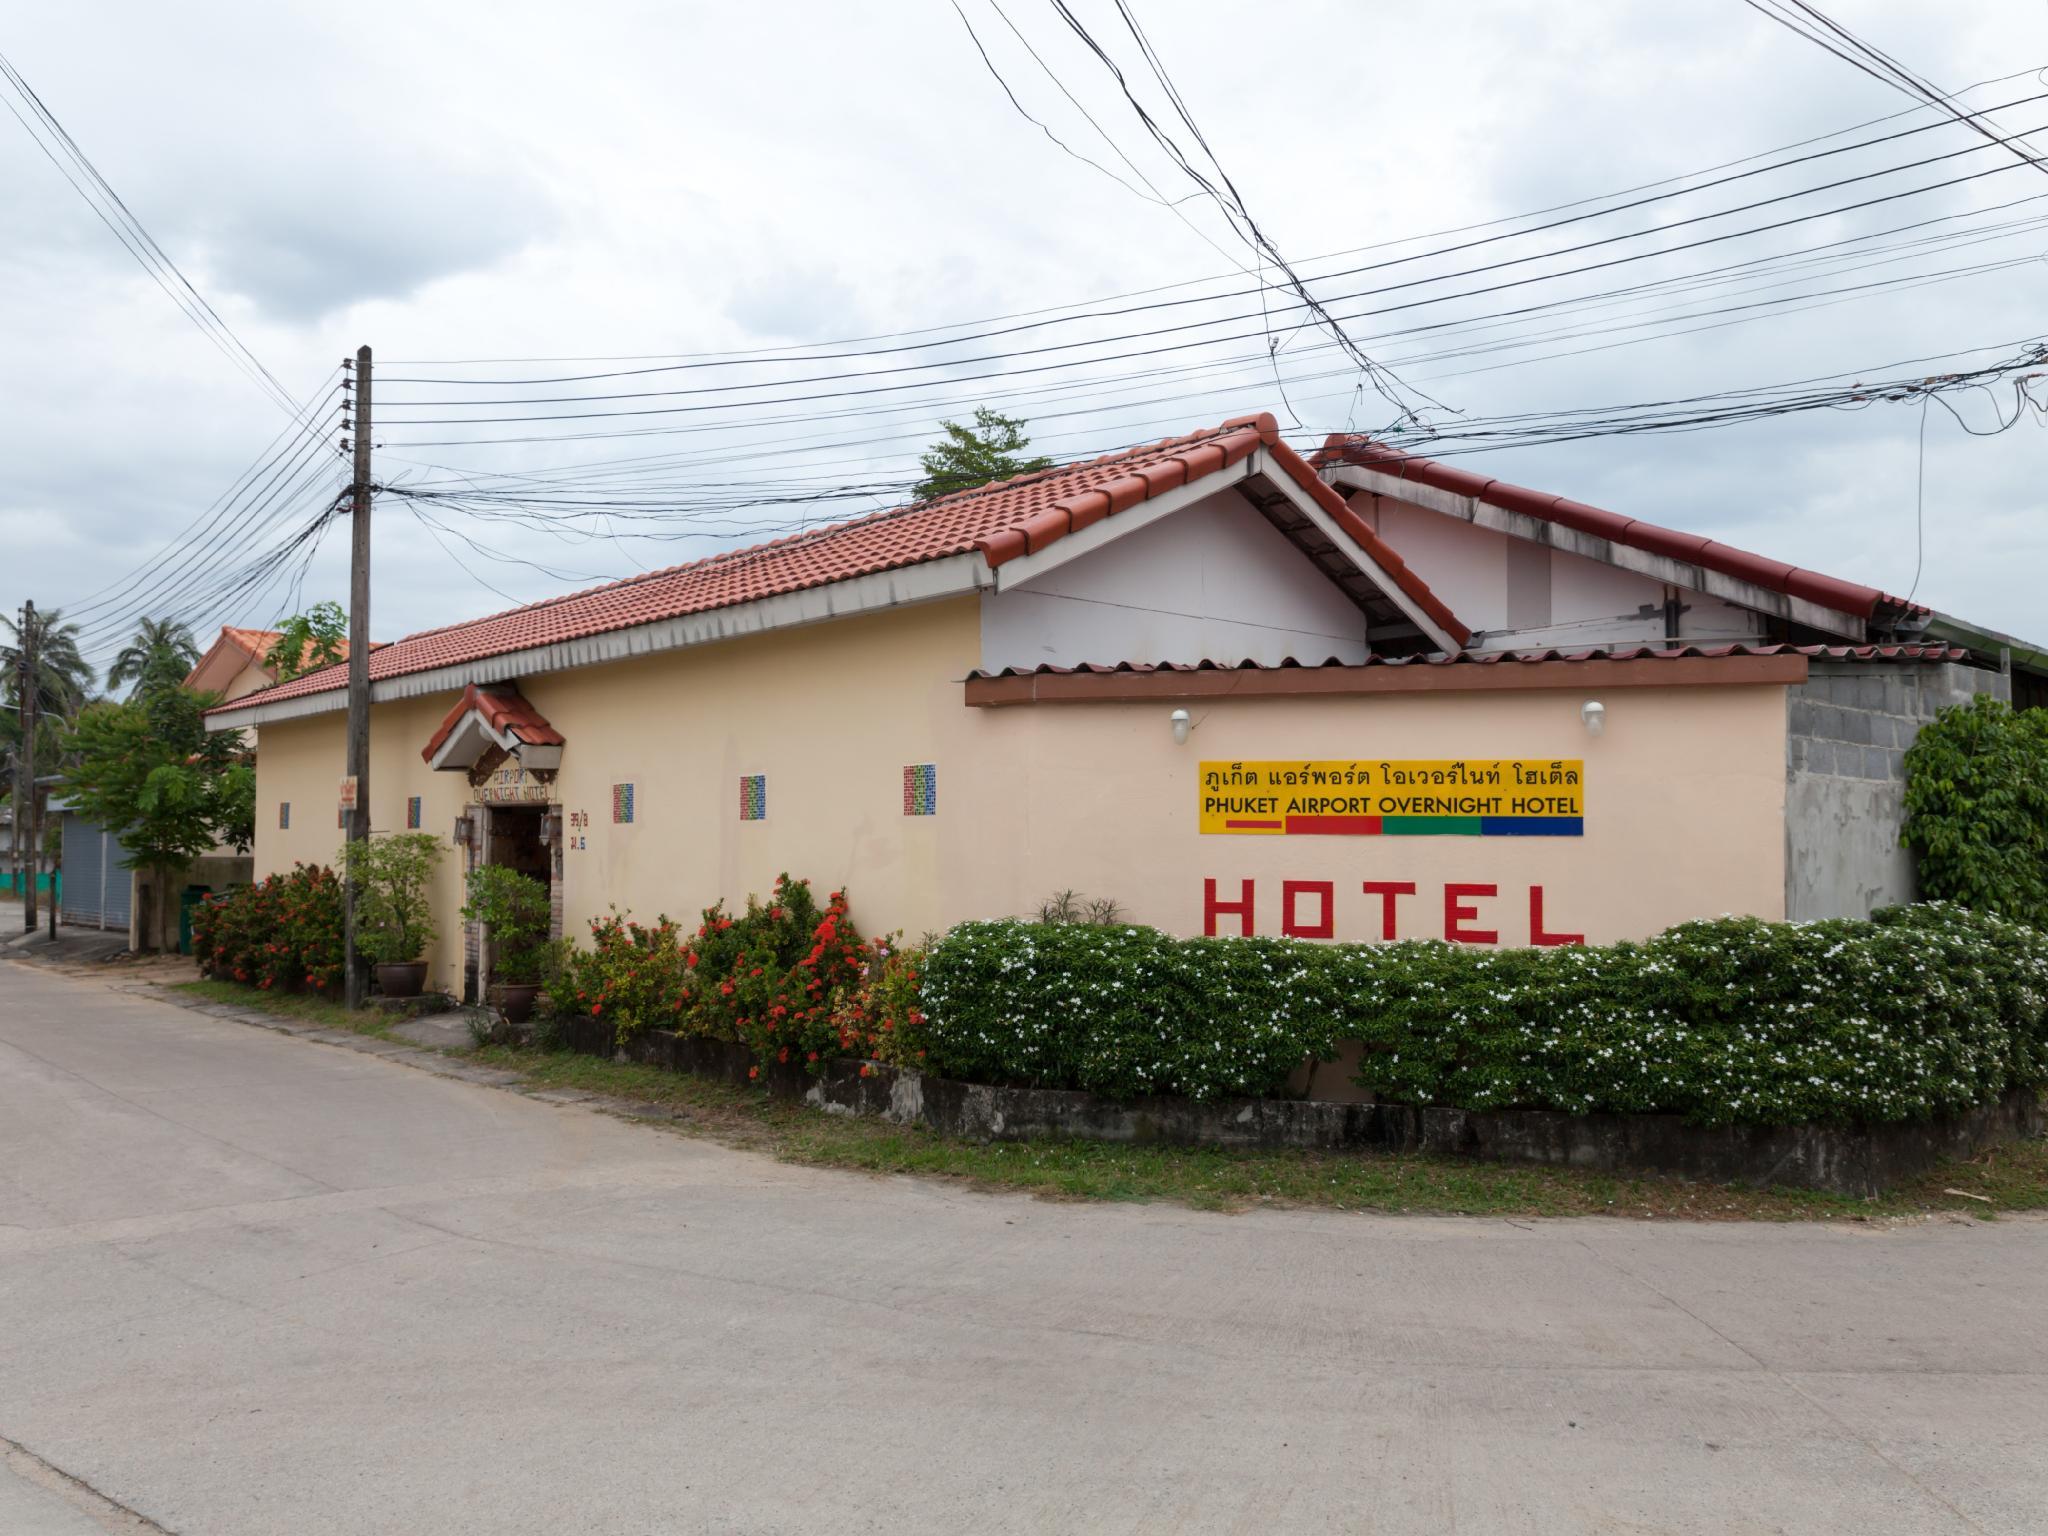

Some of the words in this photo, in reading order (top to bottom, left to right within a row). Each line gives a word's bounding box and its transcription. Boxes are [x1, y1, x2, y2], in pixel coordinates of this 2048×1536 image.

[1205, 762, 1258, 791] ภูเก็ต
[1269, 762, 1370, 785] แอร์พอร์ต
[1380, 761, 1500, 785] โอเวอร์ไนท์
[1512, 761, 1578, 785] โฮเต็ล
[1205, 797, 1279, 813] PHUKET
[1286, 797, 1371, 813] AIRPORT
[1378, 796, 1503, 814] OVERNIGHT
[1512, 797, 1579, 814] HOTEL
[1204, 878, 1585, 947] HOTEL
